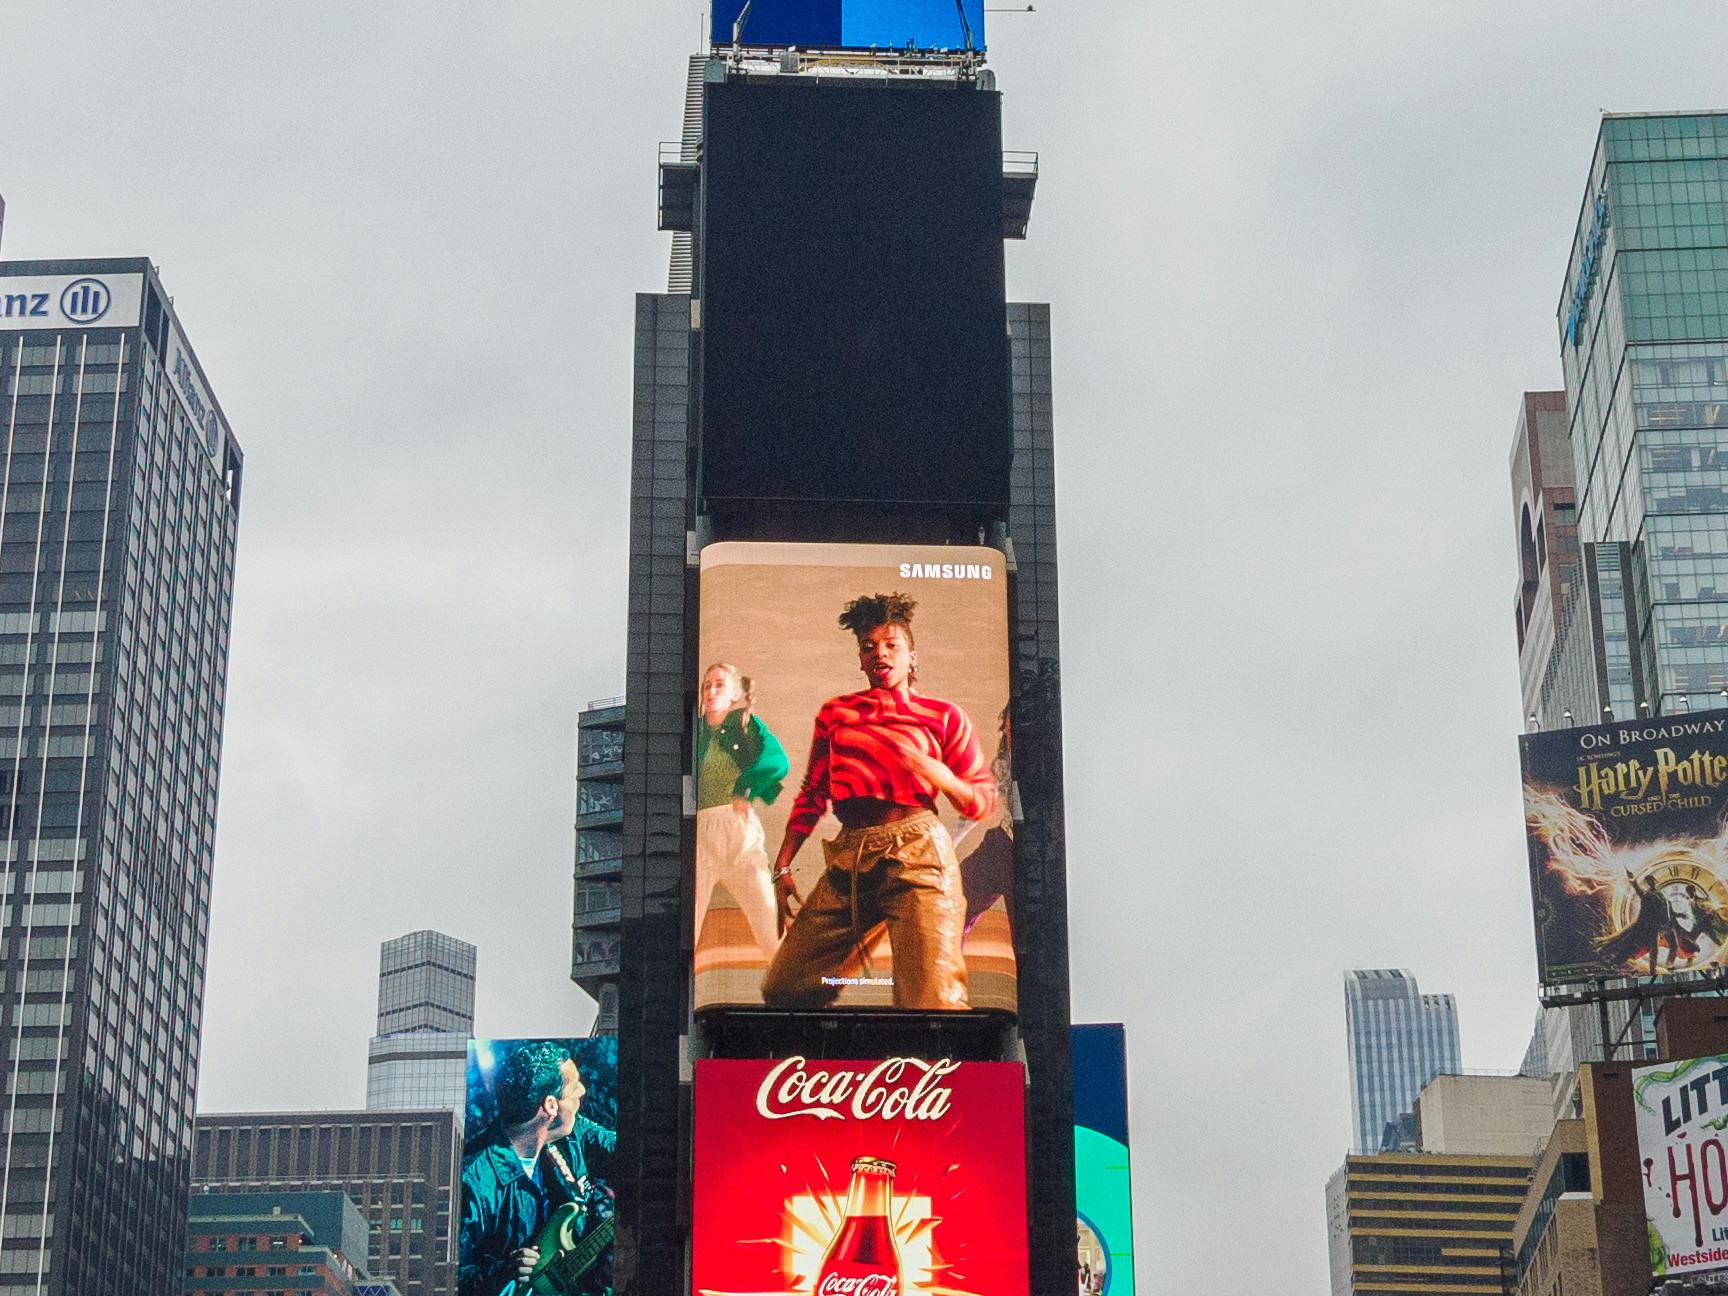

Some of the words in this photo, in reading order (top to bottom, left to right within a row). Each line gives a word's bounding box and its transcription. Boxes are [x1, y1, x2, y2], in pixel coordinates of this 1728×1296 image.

[899, 562, 992, 580] SAMSUNG
[1580, 733, 1611, 750] ON
[1619, 719, 1726, 745] BROADWAY
[1573, 757, 1654, 810] Harry
[1610, 800, 1664, 818] CURSED
[1666, 795, 1712, 811] CHILD
[756, 1055, 962, 1122] Coca-Cola
